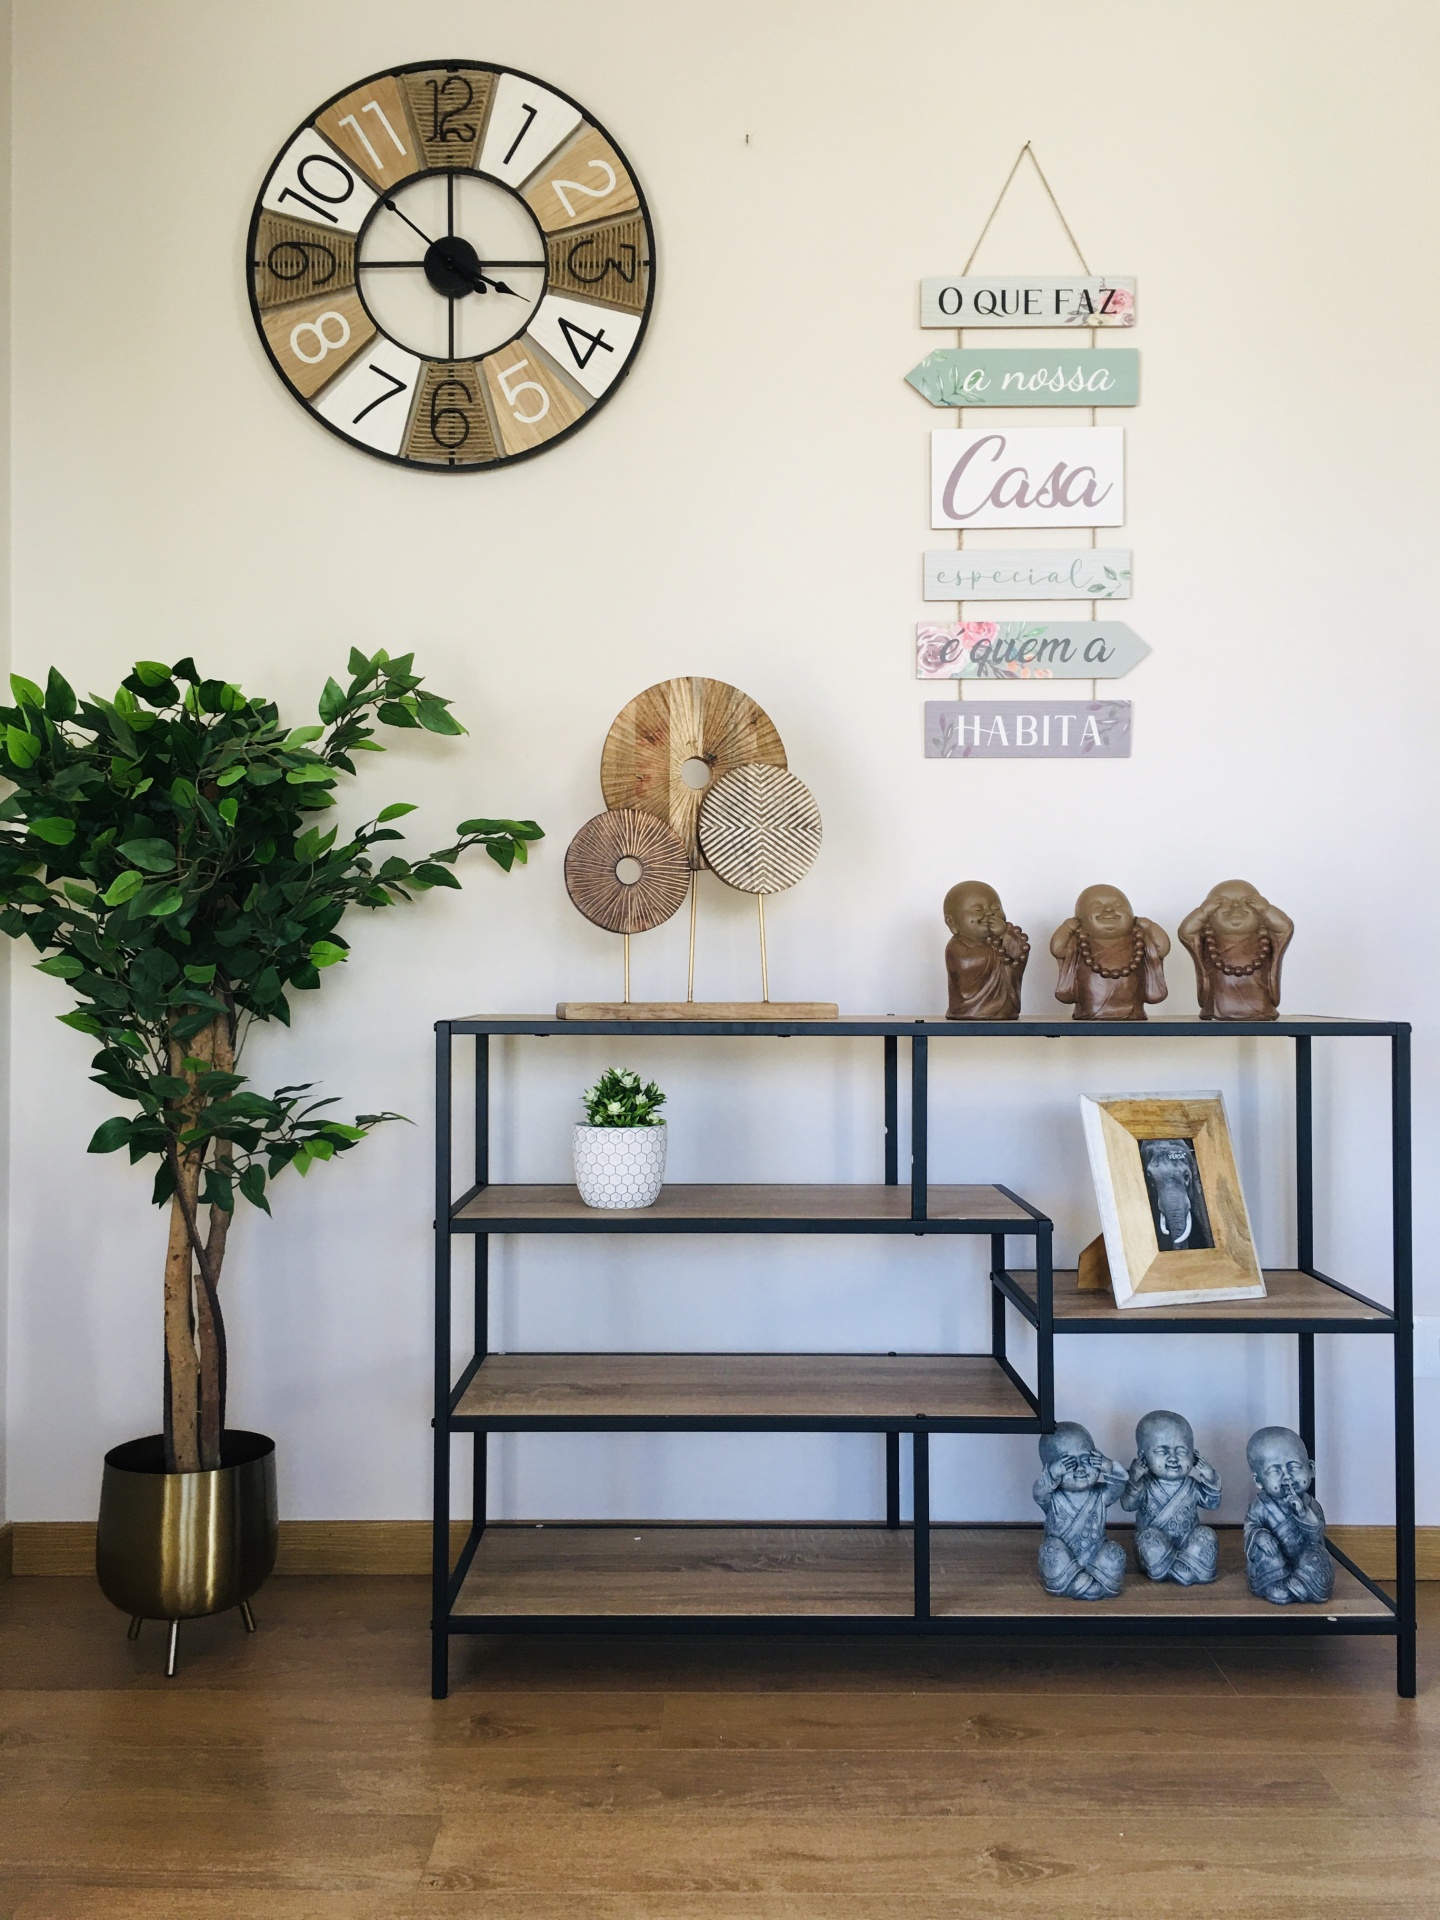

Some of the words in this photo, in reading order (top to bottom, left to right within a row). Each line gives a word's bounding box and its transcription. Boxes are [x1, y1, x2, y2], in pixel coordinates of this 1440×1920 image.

[338, 100, 407, 169] 11
[426, 76, 476, 143] 12
[503, 103, 538, 165] 1
[277, 154, 354, 224] 10
[551, 160, 616, 217] 2
[268, 241, 336, 285] 9
[568, 239, 636, 283] 3
[938, 287, 963, 315] O
[974, 289, 1042, 317] QUE
[1055, 289, 1117, 315] FAZ
[289, 311, 351, 364] 8
[558, 317, 614, 369] 4
[352, 364, 407, 424] 7
[497, 359, 550, 424] 5
[963, 369, 991, 392] a
[1001, 365, 1115, 392] nossa
[431, 380, 473, 448] 6
[942, 434, 1113, 520] Casa
[937, 559, 1093, 590] especial
[940, 628, 965, 663] é
[970, 637, 1077, 677] quem
[1083, 637, 1115, 663] a
[955, 715, 1101, 746] HABITA
